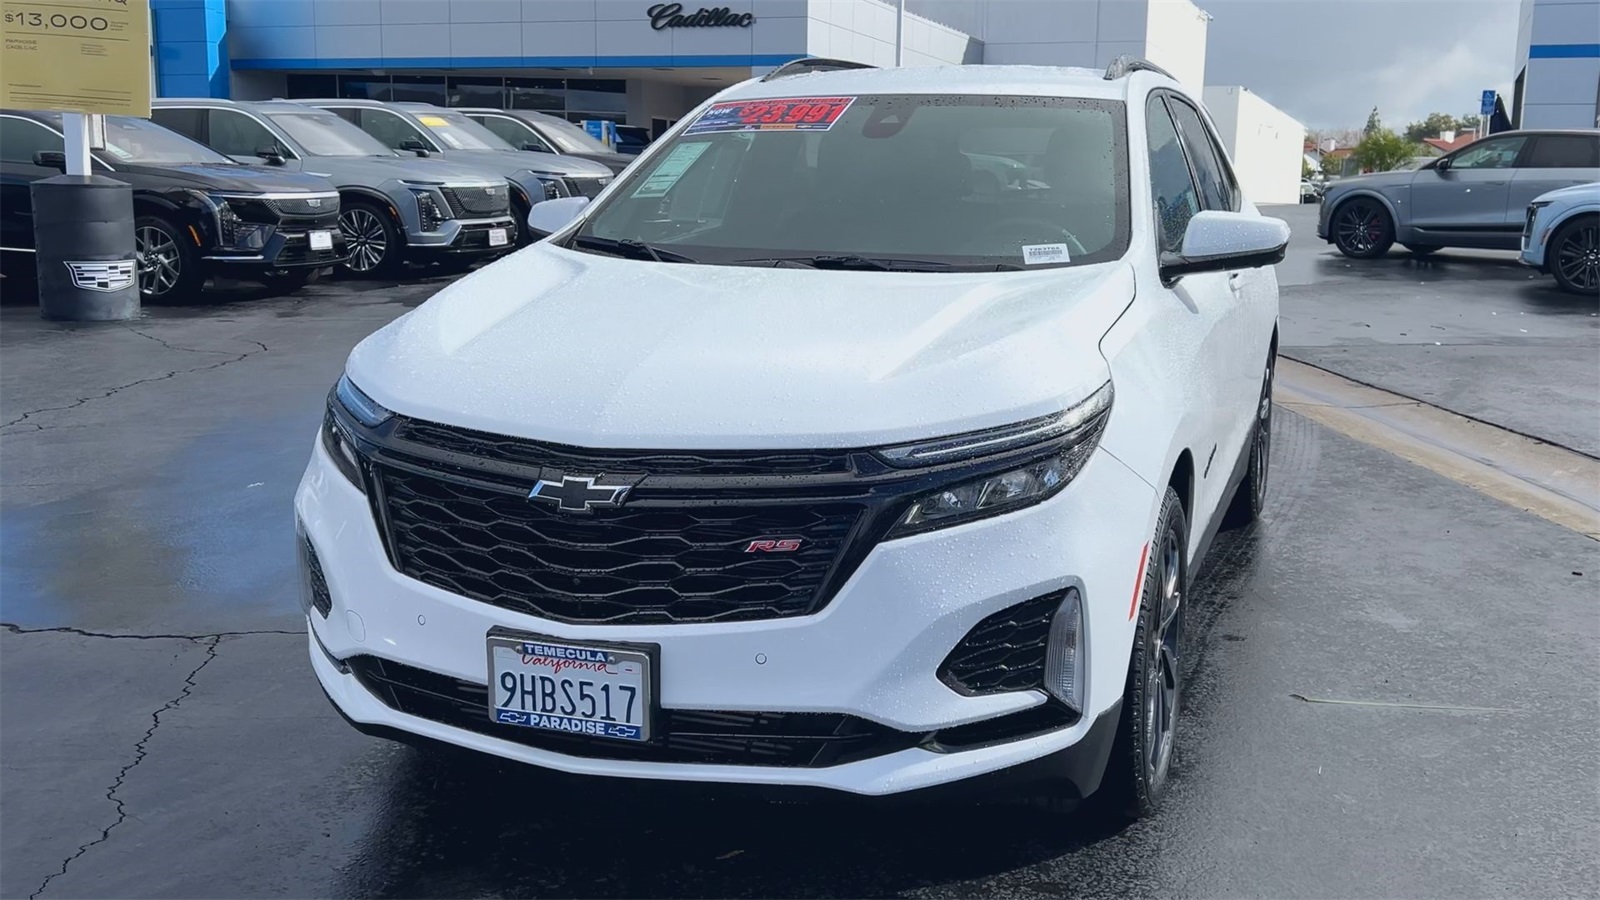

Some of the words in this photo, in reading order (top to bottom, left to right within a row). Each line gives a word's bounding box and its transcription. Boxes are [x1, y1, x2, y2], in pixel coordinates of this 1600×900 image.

[5, 12, 108, 31] $13,000
[647, 3, 753, 30] Cadillac
[739, 104, 845, 124] $23,991
[744, 539, 803, 553] RS
[525, 644, 606, 662] TEMECULA
[500, 671, 637, 724] 9HBS517
[530, 714, 605, 735] PARADISE
